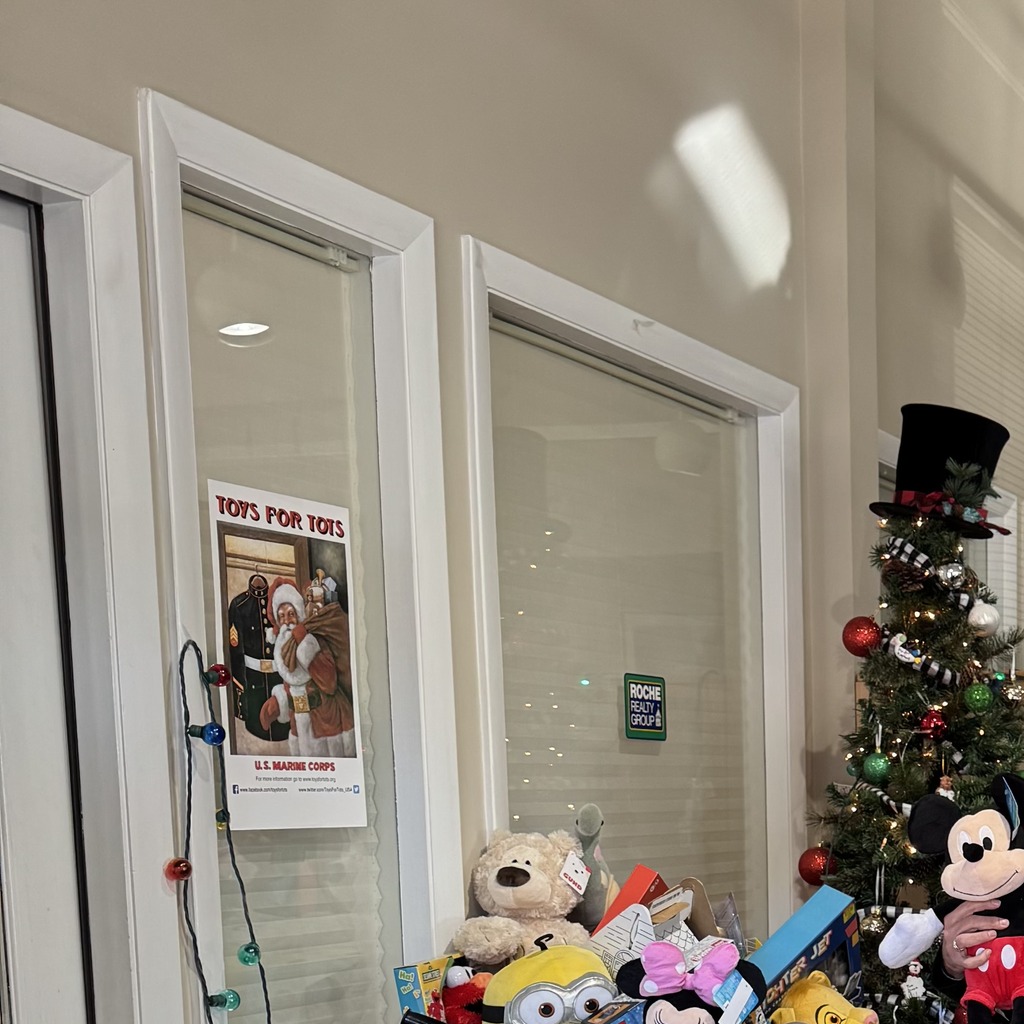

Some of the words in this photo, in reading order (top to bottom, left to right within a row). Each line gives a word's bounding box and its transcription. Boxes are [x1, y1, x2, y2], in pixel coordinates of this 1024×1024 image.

[215, 495, 260, 521] TOYS
[265, 505, 303, 530] FOR
[306, 514, 345, 538] TOTS
[629, 683, 661, 701] ROCHE
[630, 700, 655, 713] REALTY
[631, 713, 655, 727] GROUP
[254, 760, 271, 771] U.S.
[272, 761, 307, 771] MARINE
[308, 762, 336, 772] CORPS
[563, 872, 583, 891] GUND
[810, 929, 833, 960] JET
[399, 970, 415, 982] Ha!
[762, 955, 808, 1004] GHTER
